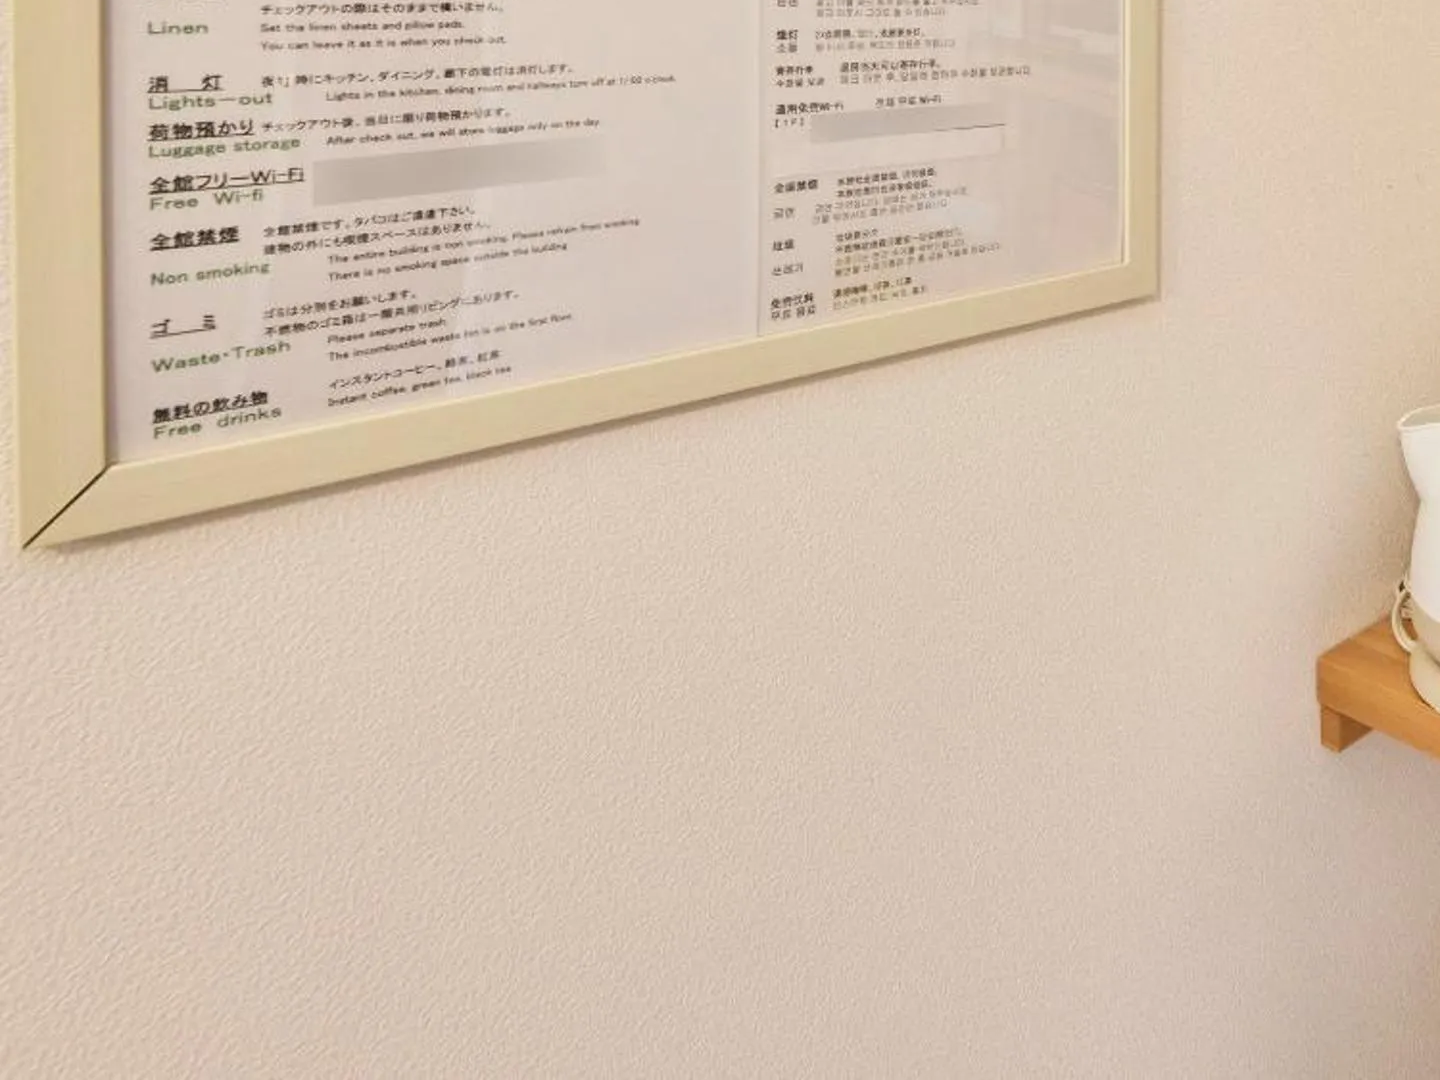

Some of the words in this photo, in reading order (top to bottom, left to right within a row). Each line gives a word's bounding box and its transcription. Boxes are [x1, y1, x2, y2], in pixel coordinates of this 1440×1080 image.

[147, 21, 209, 35] Linen
[148, 119, 254, 141] 荷物預かり
[148, 142, 227, 160] Luggage
[233, 138, 301, 155] storage
[149, 166, 304, 194] 全館フリーWi-Fi
[149, 194, 198, 211] Free
[149, 225, 240, 251] 全館禁煙
[150, 269, 189, 287] Non
[195, 259, 271, 283] smoking
[153, 389, 268, 423] 無料の飲み物
[153, 418, 202, 440] Free
[217, 403, 281, 428] drinks
